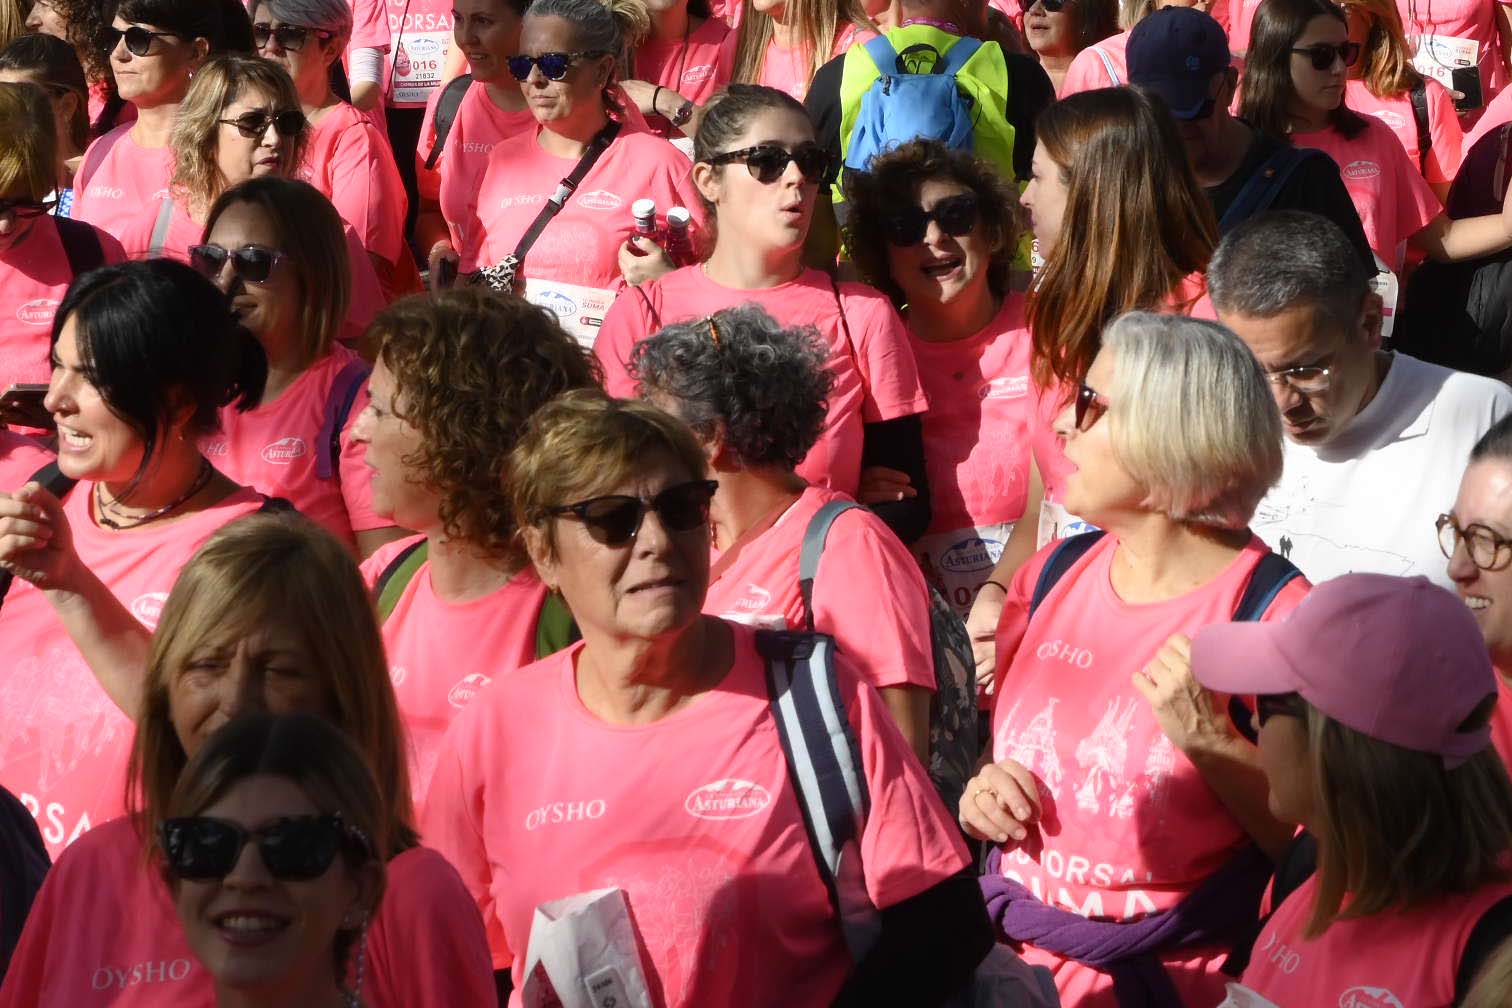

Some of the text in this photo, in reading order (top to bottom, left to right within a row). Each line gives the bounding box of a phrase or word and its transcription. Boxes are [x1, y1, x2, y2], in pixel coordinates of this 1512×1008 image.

[389, 12, 456, 31] DORSA
[525, 799, 607, 831] OYSHO
[91, 960, 191, 990] OYSHO
